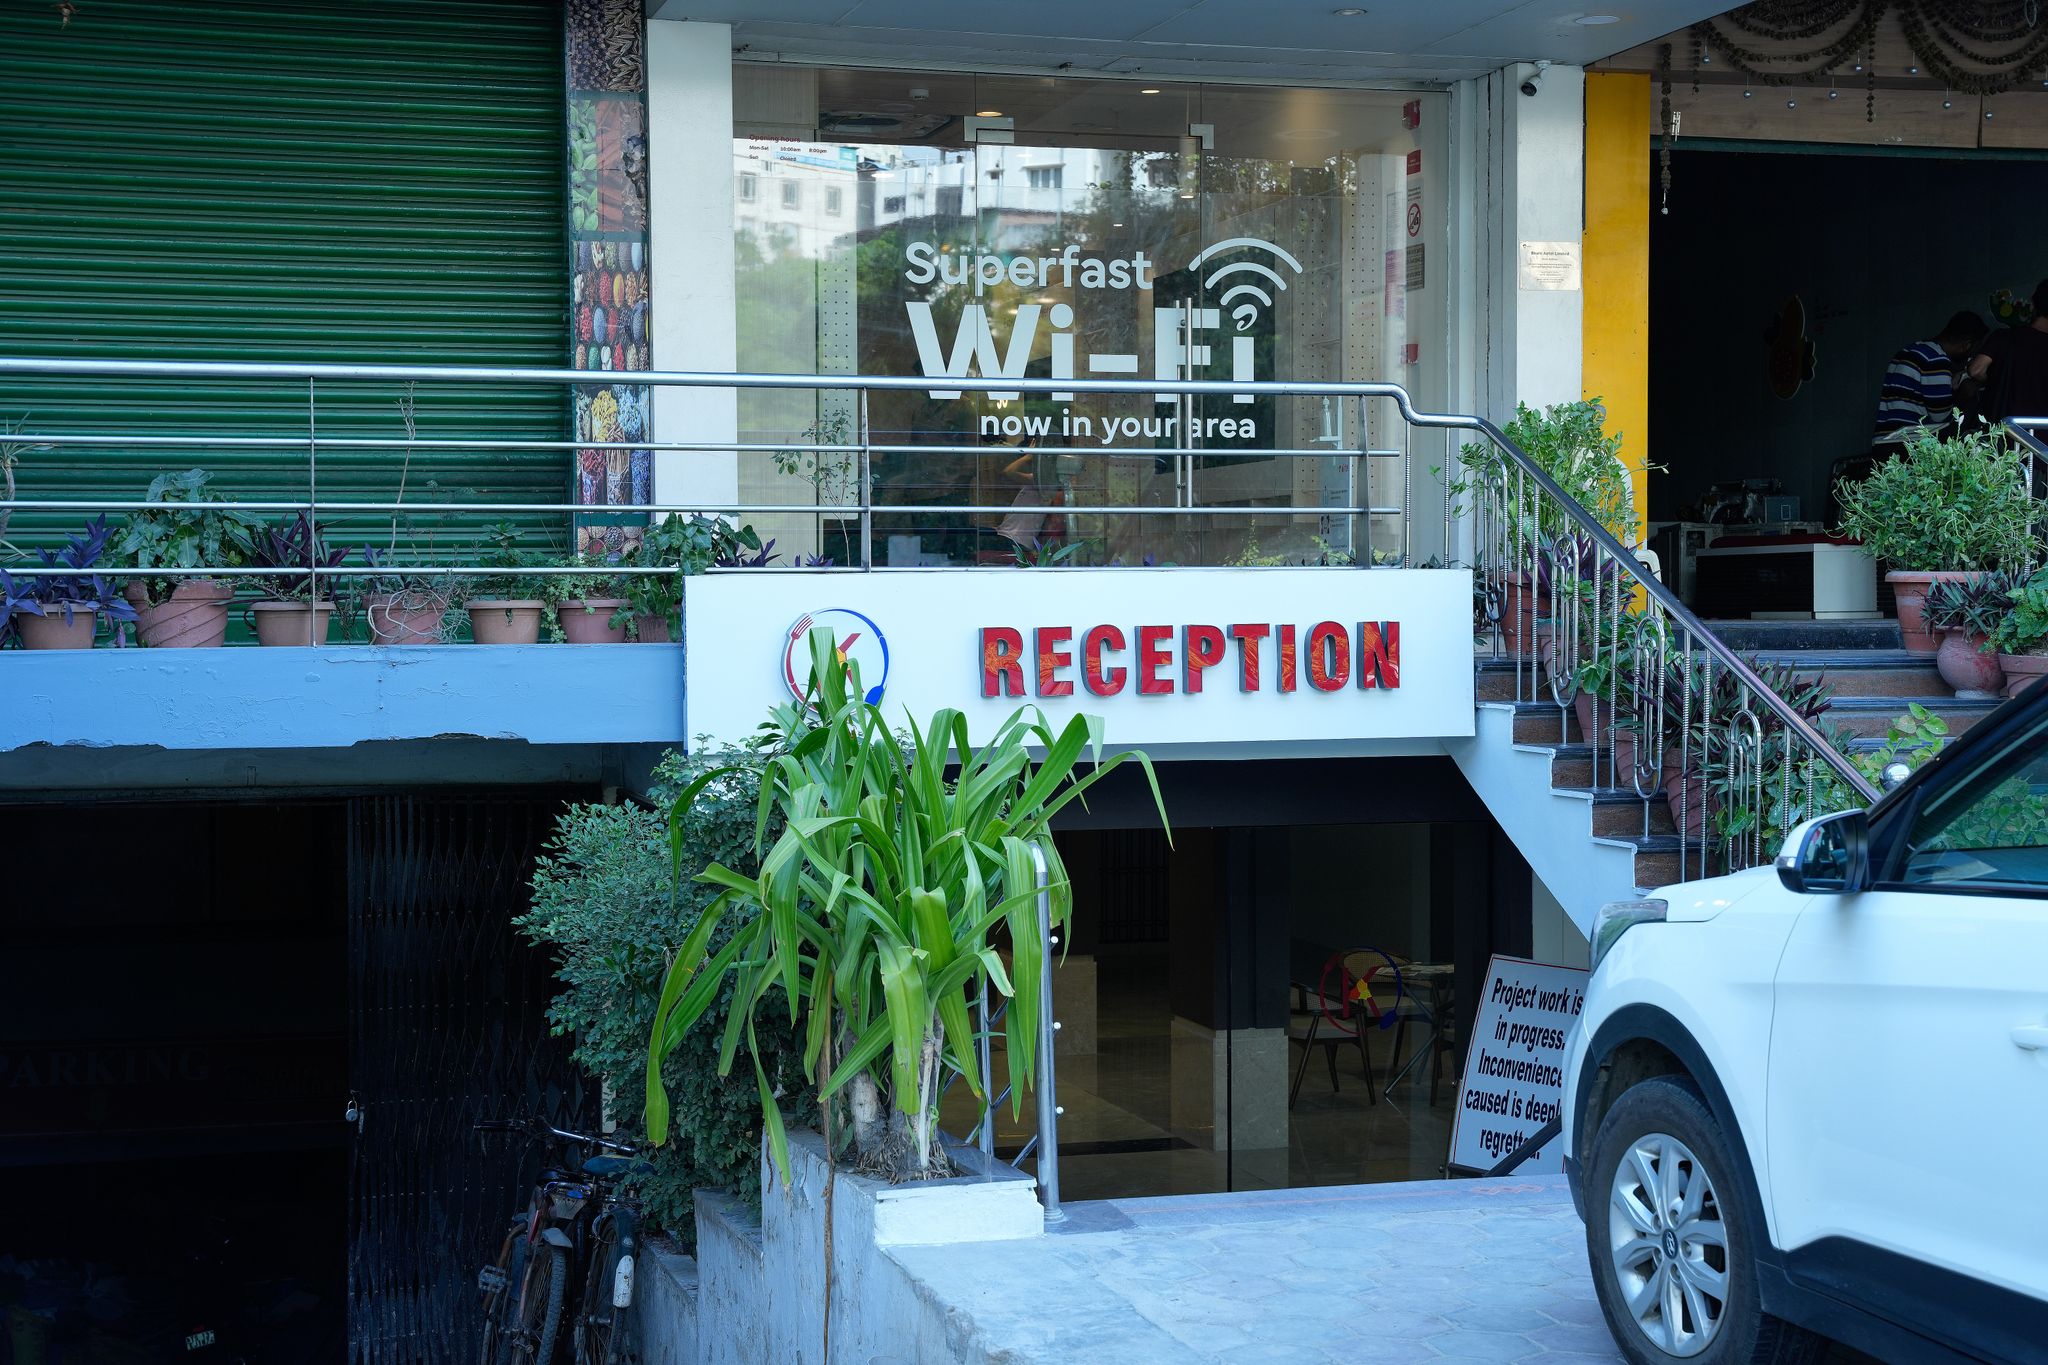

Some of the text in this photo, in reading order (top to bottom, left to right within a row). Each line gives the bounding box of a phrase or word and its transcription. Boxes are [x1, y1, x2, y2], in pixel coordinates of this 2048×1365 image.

[905, 241, 1153, 297] Superfast
[905, 300, 1258, 404] Wi-Fi
[980, 408, 1256, 445] now in your area
[979, 620, 1401, 698] RECEPTION
[1491, 977, 1584, 1016] Project work is
[1494, 1014, 1566, 1052] in progress.
[1465, 1088, 1562, 1124] caused is deepl
